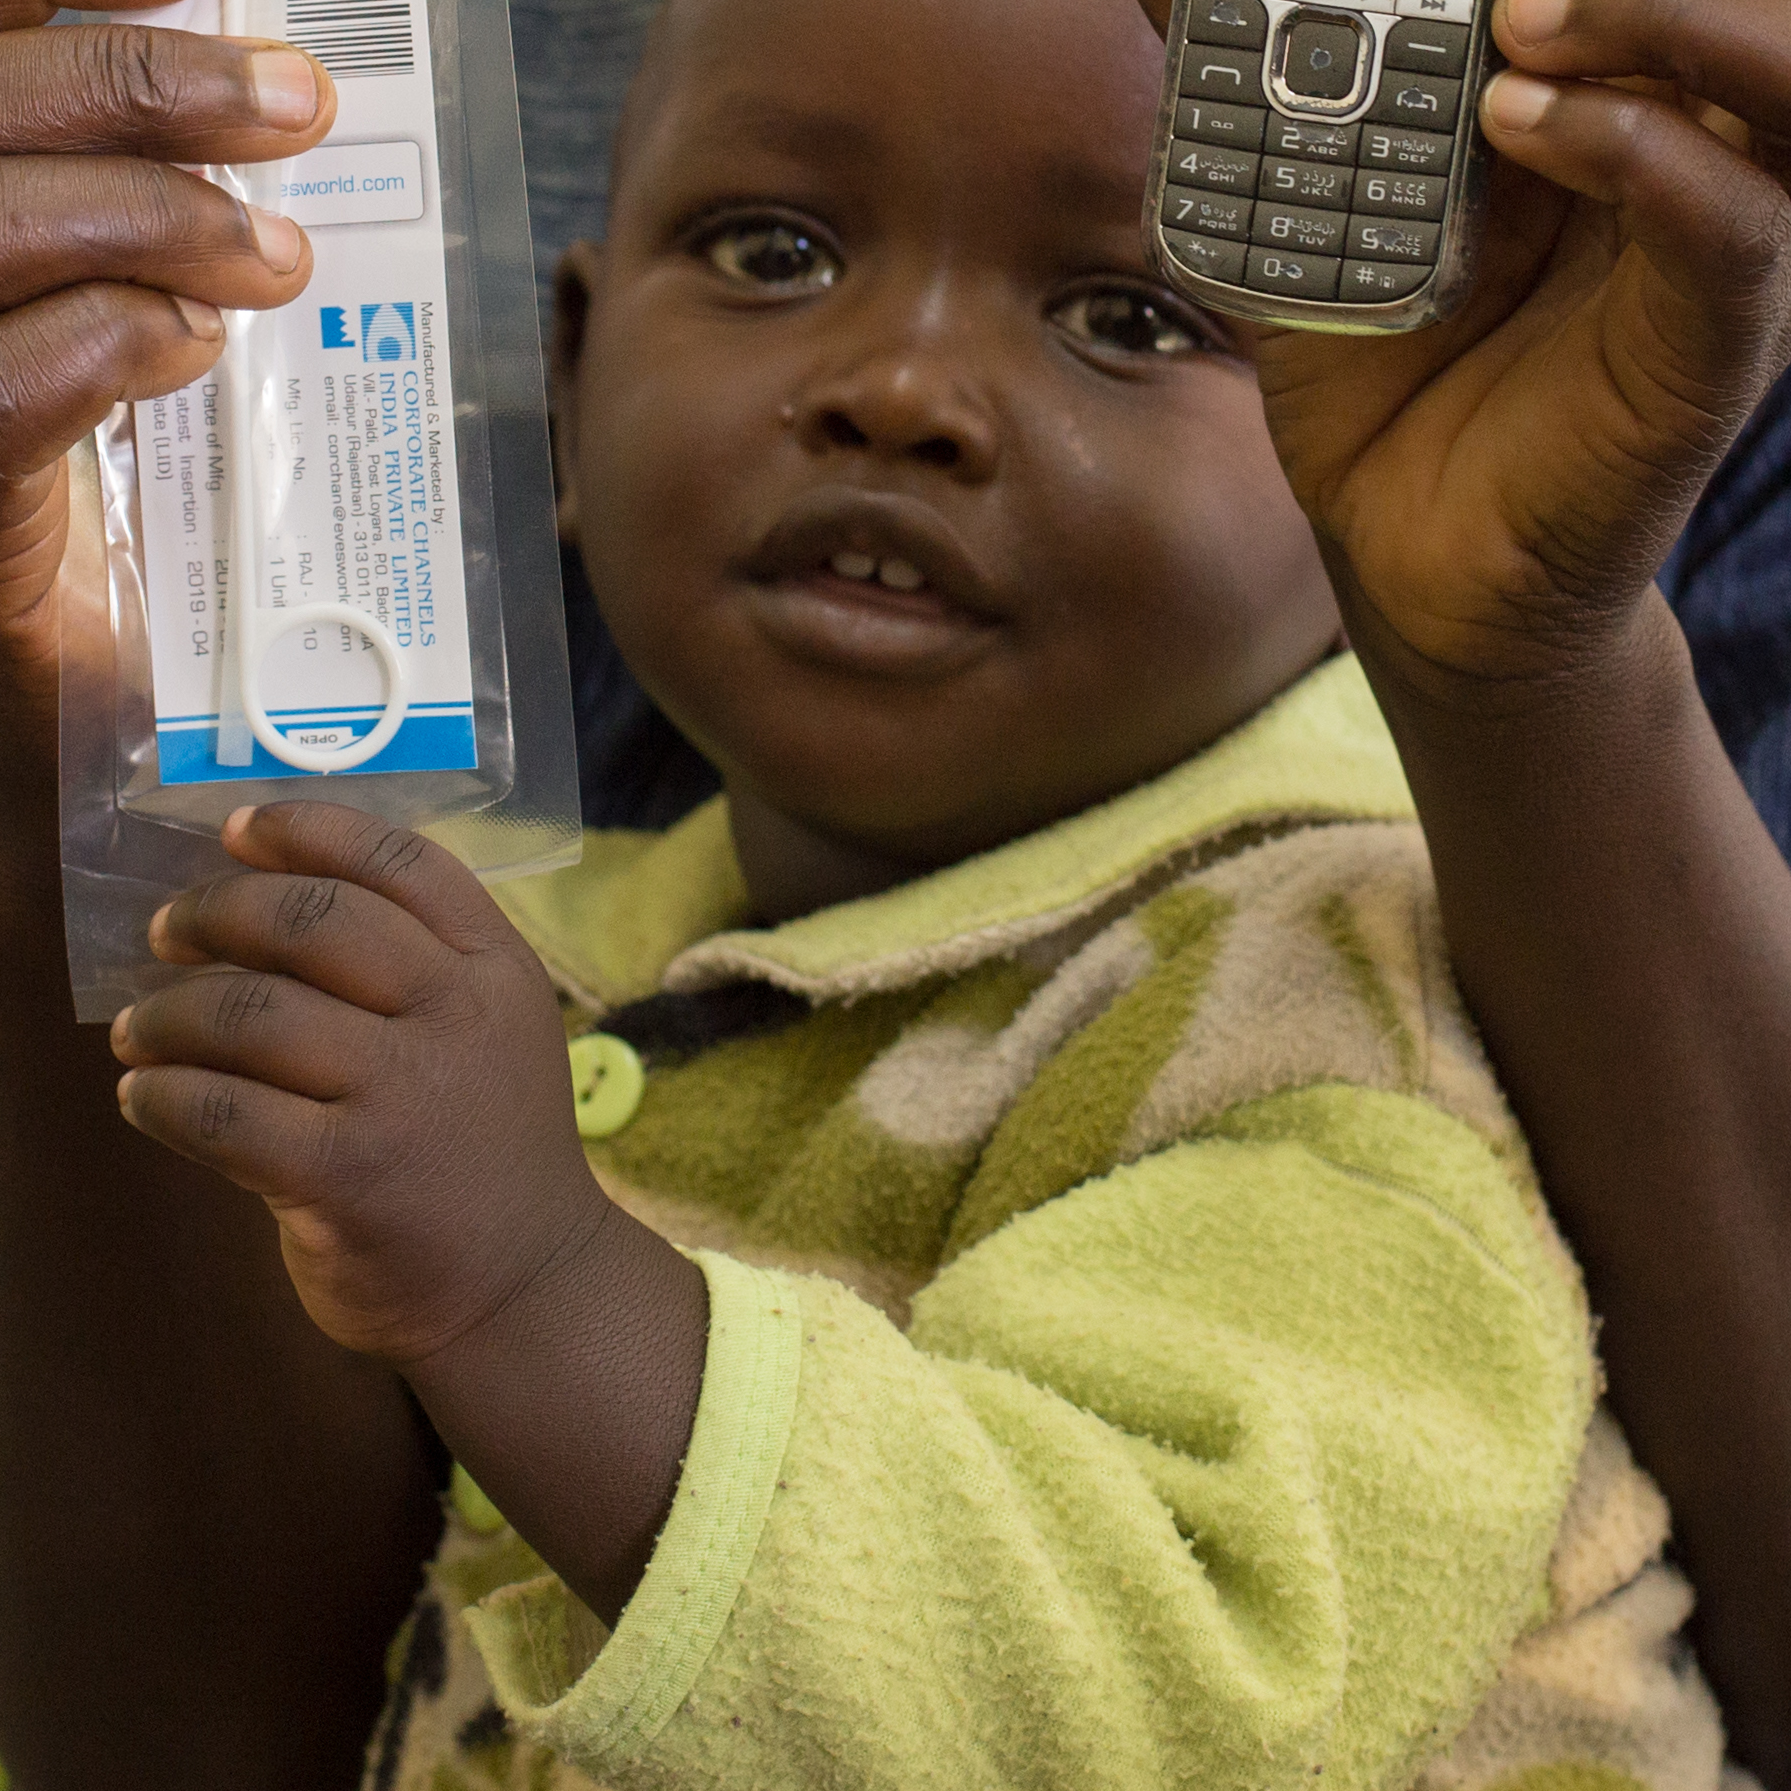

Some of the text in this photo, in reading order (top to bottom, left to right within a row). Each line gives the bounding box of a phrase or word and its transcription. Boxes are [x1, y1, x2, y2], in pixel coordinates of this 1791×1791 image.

[1191, 107, 1201, 129] 1
[1280, 125, 1301, 150] 2
[1306, 143, 1340, 156] ABC
[1370, 134, 1391, 158] 3
[1179, 152, 1199, 175] 4
[1397, 151, 1430, 164] DEF
[1208, 170, 1236, 184] GHI
[1274, 166, 1296, 190] 5
[1300, 185, 1334, 197] JKL
[1366, 179, 1387, 201] 6
[1391, 195, 1428, 207] MNO
[1174, 199, 1194, 221] 7
[1197, 218, 1238, 231] PQRS
[1270, 216, 1290, 239] 8
[1297, 233, 1327, 246] TUV
[1263, 258, 1281, 278] 0
[419, 301, 439, 407] Manufactured
[202, 382, 221, 426] Date
[283, 377, 302, 416] Mfg.
[323, 375, 340, 427] email:
[340, 374, 360, 431] Udaipur
[360, 408, 379, 449] Paldi,
[426, 412, 439, 425] &
[206, 432, 223, 451] of
[151, 435, 173, 481] (LID)
[427, 430, 444, 502] Marketed
[291, 456, 307, 486] No.
[343, 434, 366, 518] (Rajasthan)
[366, 453, 382, 490] Post
[179, 454, 201, 534] Insertion
[366, 493, 386, 547] Loyara,
[378, 371, 412, 649] INDIA PRIVATE LIMITED
[401, 370, 435, 648] CORPORATE CHANNELS
[428, 506, 446, 526] by
[353, 530, 368, 564] 313
[268, 556, 285, 565] 1
[297, 551, 314, 586] RAJ
[185, 559, 207, 613] 2019
[371, 586, 392, 628] Badg
[190, 629, 209, 657] 04
[299, 734, 339, 745] OPEN
